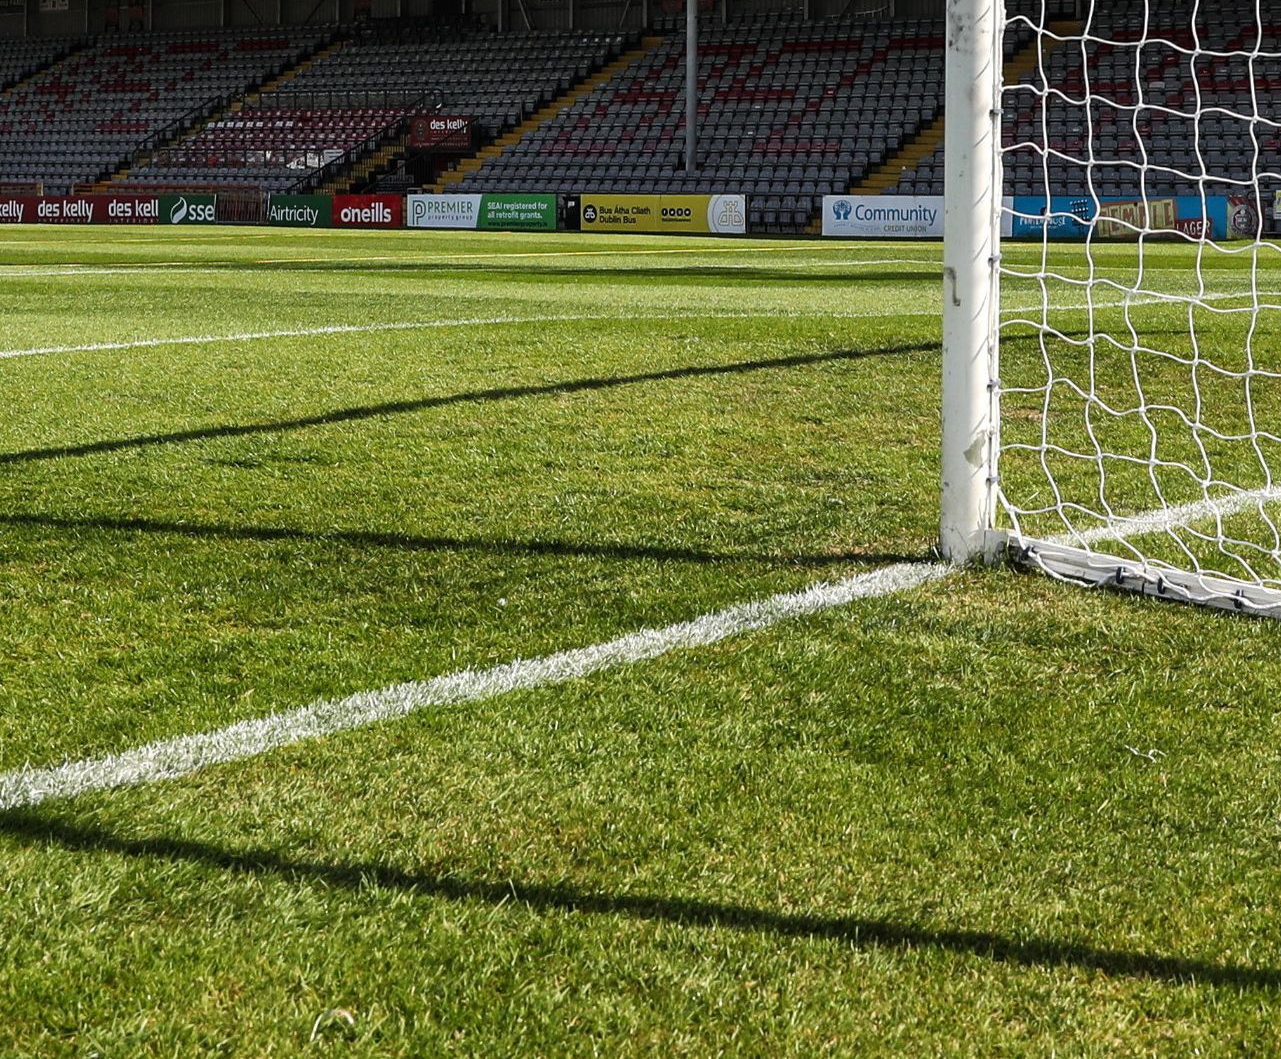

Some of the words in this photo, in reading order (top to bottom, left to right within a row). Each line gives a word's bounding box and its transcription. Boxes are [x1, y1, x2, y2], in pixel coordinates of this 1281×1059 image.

[430, 119, 445, 130] des
[38, 200, 60, 217] des
[63, 199, 94, 223] kelly
[108, 199, 132, 217] des
[427, 201, 473, 214] PREMIER
[503, 201, 537, 211] registered
[537, 202, 548, 210] for
[599, 207, 613, 215] Bus
[614, 204, 630, 215] Átha
[631, 206, 651, 215] Cliath
[188, 204, 215, 221] sse
[269, 204, 319, 225] Airtricity
[456, 214, 473, 222] group
[487, 211, 495, 219] all
[496, 210, 519, 219] retrofit
[855, 204, 938, 227] Community
[599, 215, 622, 224] Dublin
[623, 216, 637, 224] Bus
[883, 225, 905, 233] CREDIT
[906, 225, 927, 233] UNION
